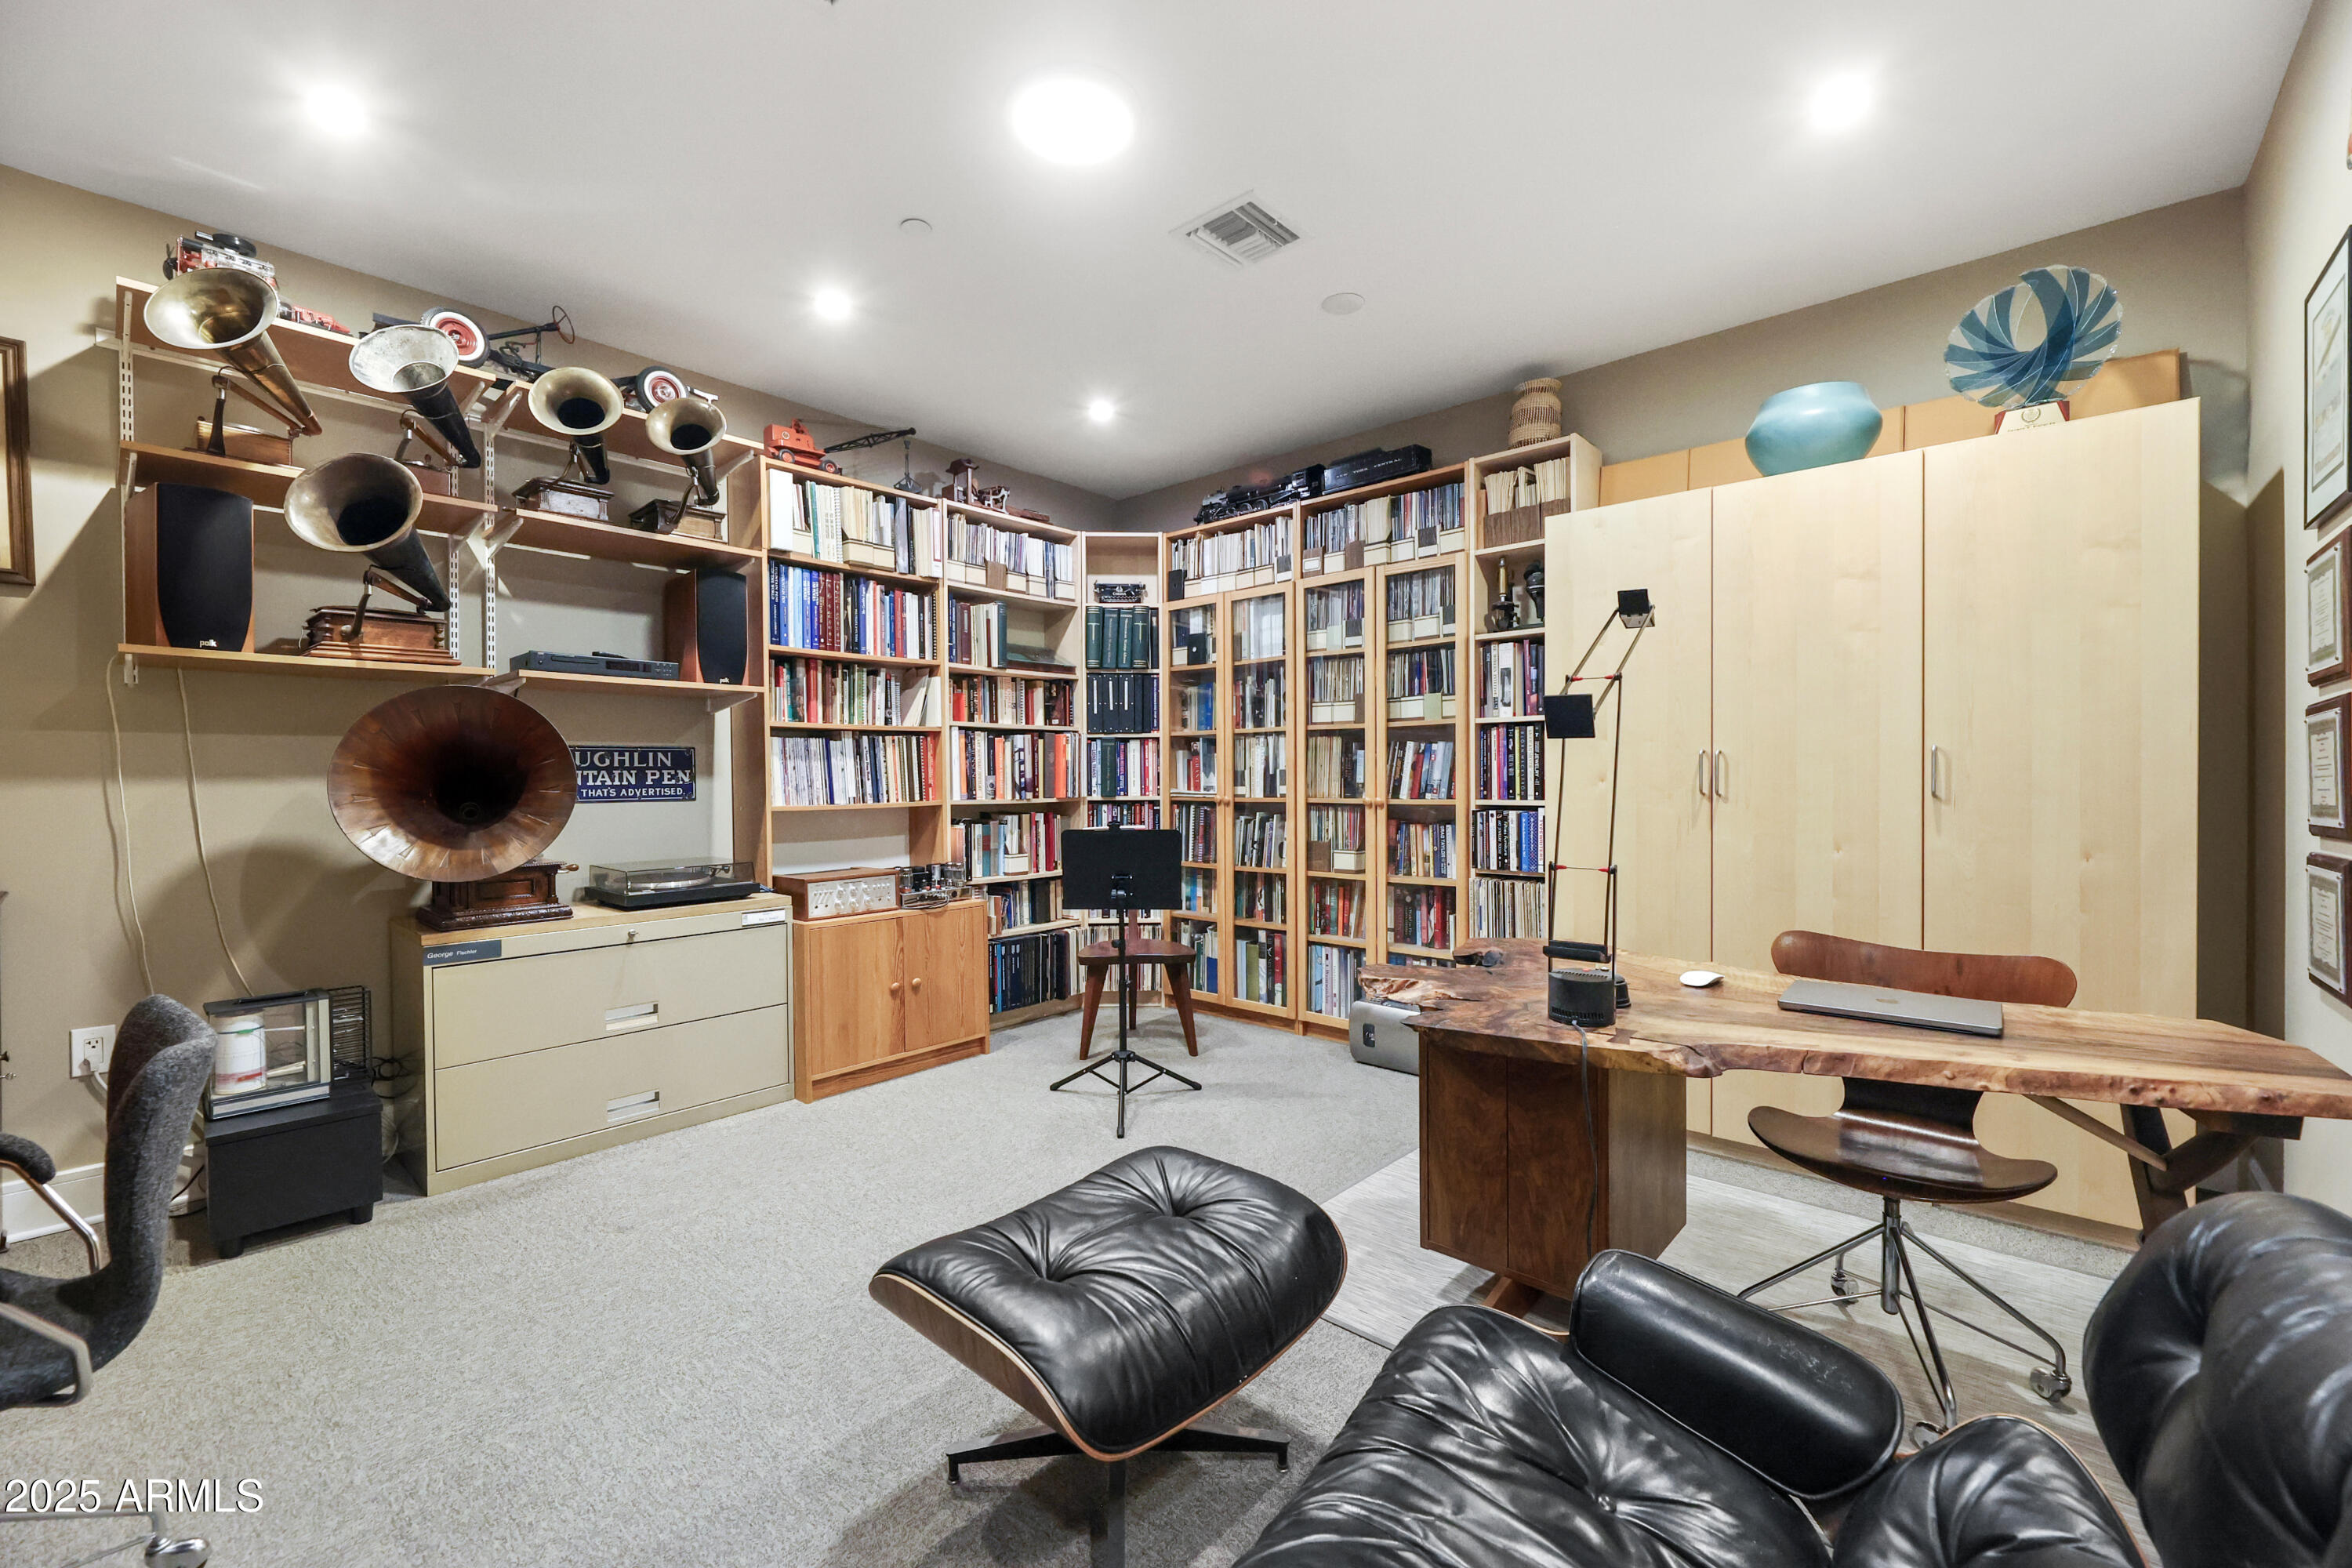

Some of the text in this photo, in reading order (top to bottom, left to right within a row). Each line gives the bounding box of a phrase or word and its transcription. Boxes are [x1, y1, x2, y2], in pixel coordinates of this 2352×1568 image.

[200, 639, 217, 648] polk
[575, 751, 671, 768] UGHLIN
[645, 769, 691, 786] PEN
[580, 786, 687, 797] THAT'S ADVERTISED.
[426, 951, 454, 960] George
